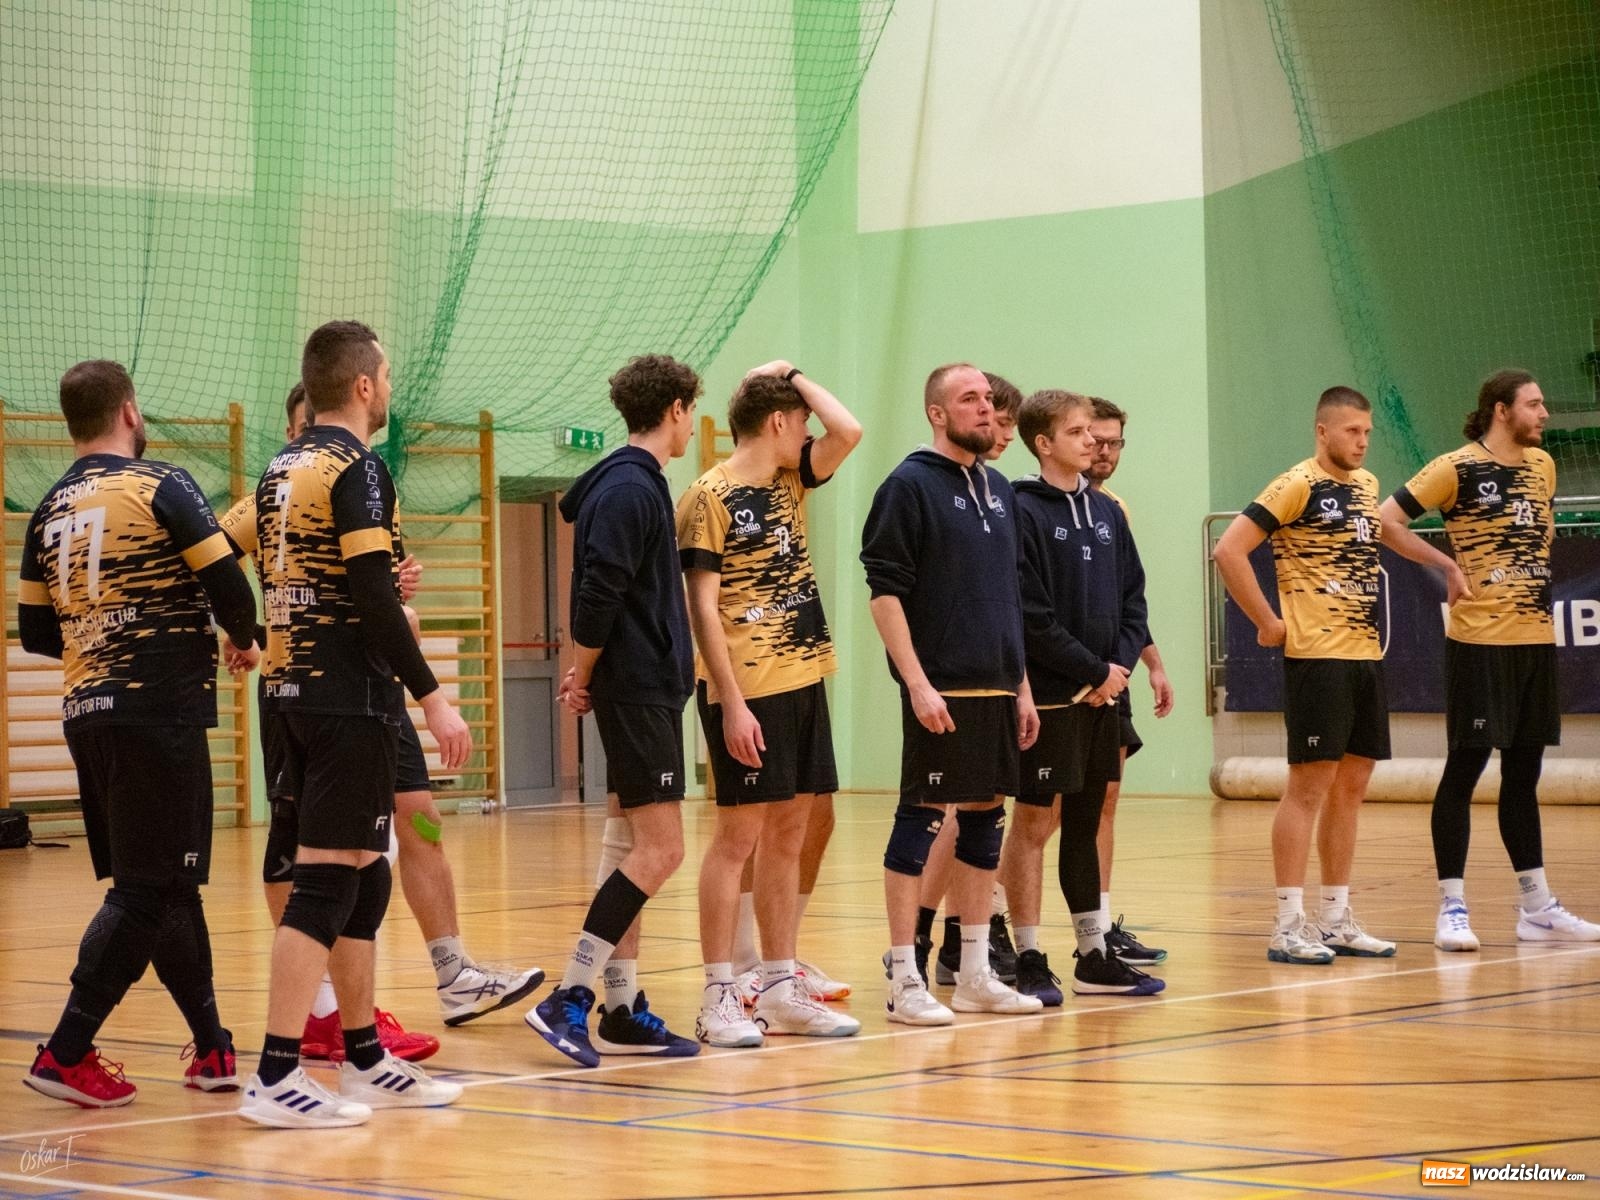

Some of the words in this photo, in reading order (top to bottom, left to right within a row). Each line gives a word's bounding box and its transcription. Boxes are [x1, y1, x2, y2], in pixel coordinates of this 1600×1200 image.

[1512, 500, 1535, 527] 23
[735, 521, 761, 535] radlin
[983, 519, 991, 534] 4
[1353, 517, 1371, 543] 10
[44, 506, 106, 607] 77
[102, 606, 137, 629] KLUB
[81, 699, 95, 714] FOR
[95, 695, 114, 710] FUN
